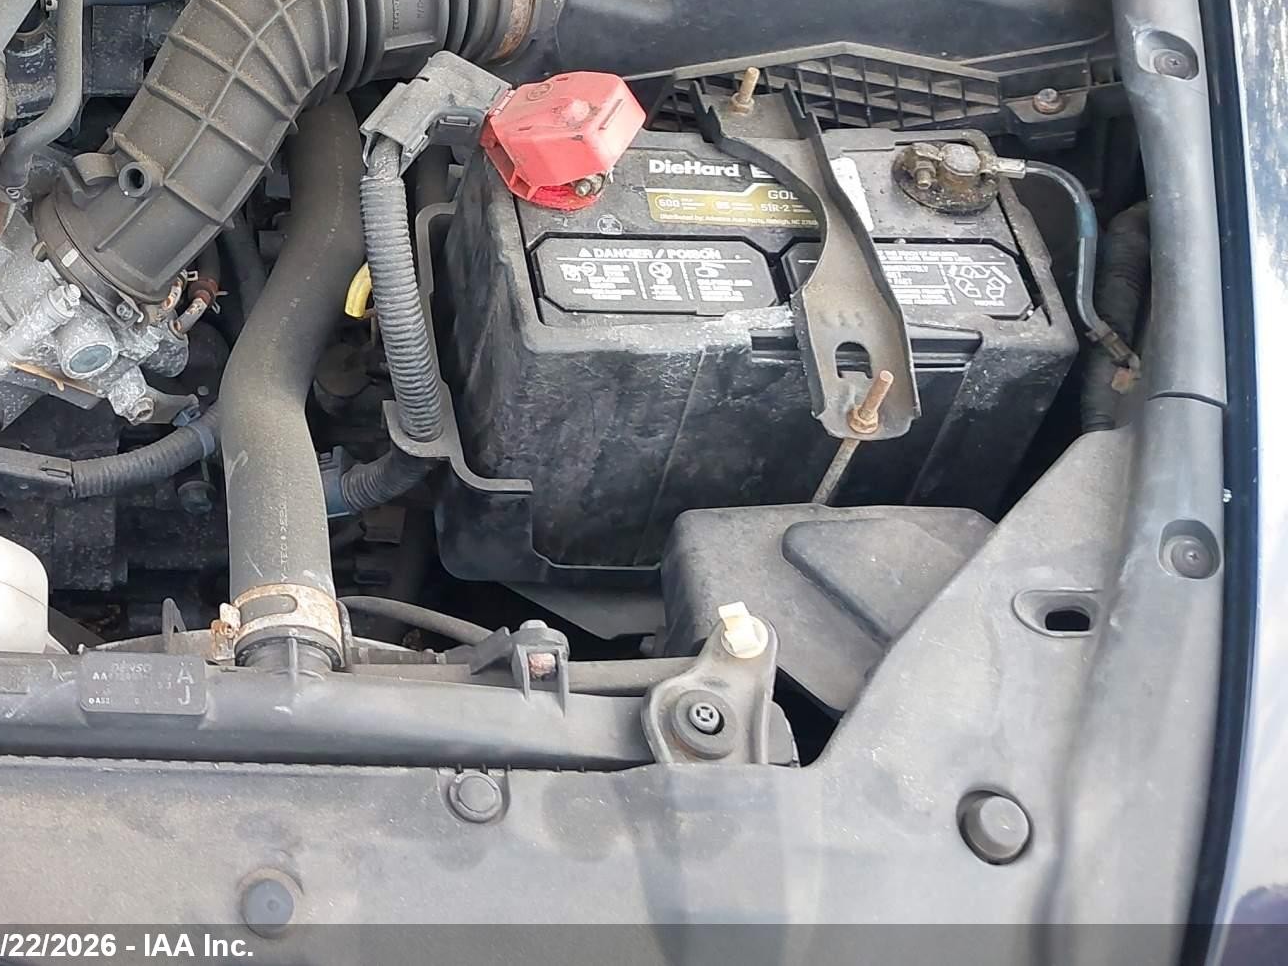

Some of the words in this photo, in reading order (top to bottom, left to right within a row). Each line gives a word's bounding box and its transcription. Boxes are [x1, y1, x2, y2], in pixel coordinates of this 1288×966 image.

[649, 159, 740, 177] DieHard
[760, 203, 791, 212] 51R-2
[594, 248, 653, 258] DANGER
[667, 248, 721, 260] POISON
